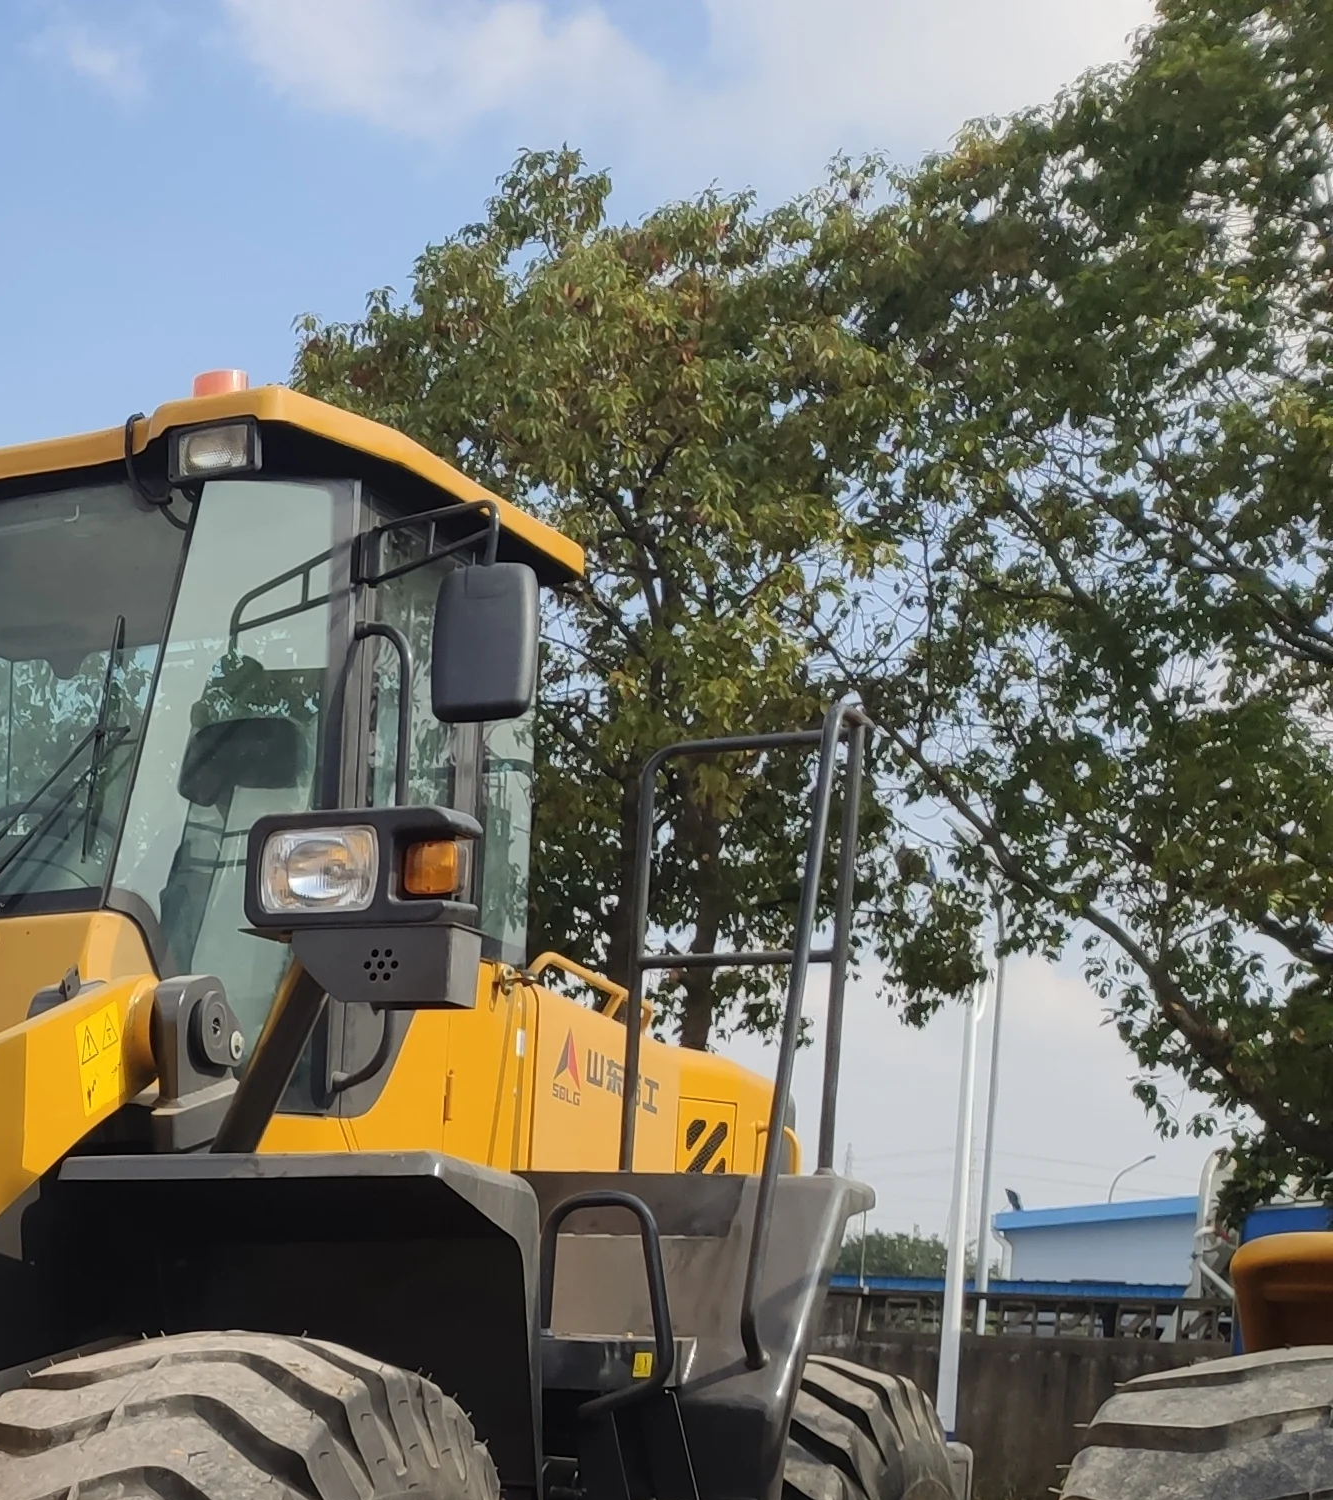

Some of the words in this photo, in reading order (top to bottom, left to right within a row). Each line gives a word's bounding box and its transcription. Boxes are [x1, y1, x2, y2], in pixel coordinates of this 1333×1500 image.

[552, 1083, 581, 1106] SDLG
[586, 1049, 659, 1114] 山东工
